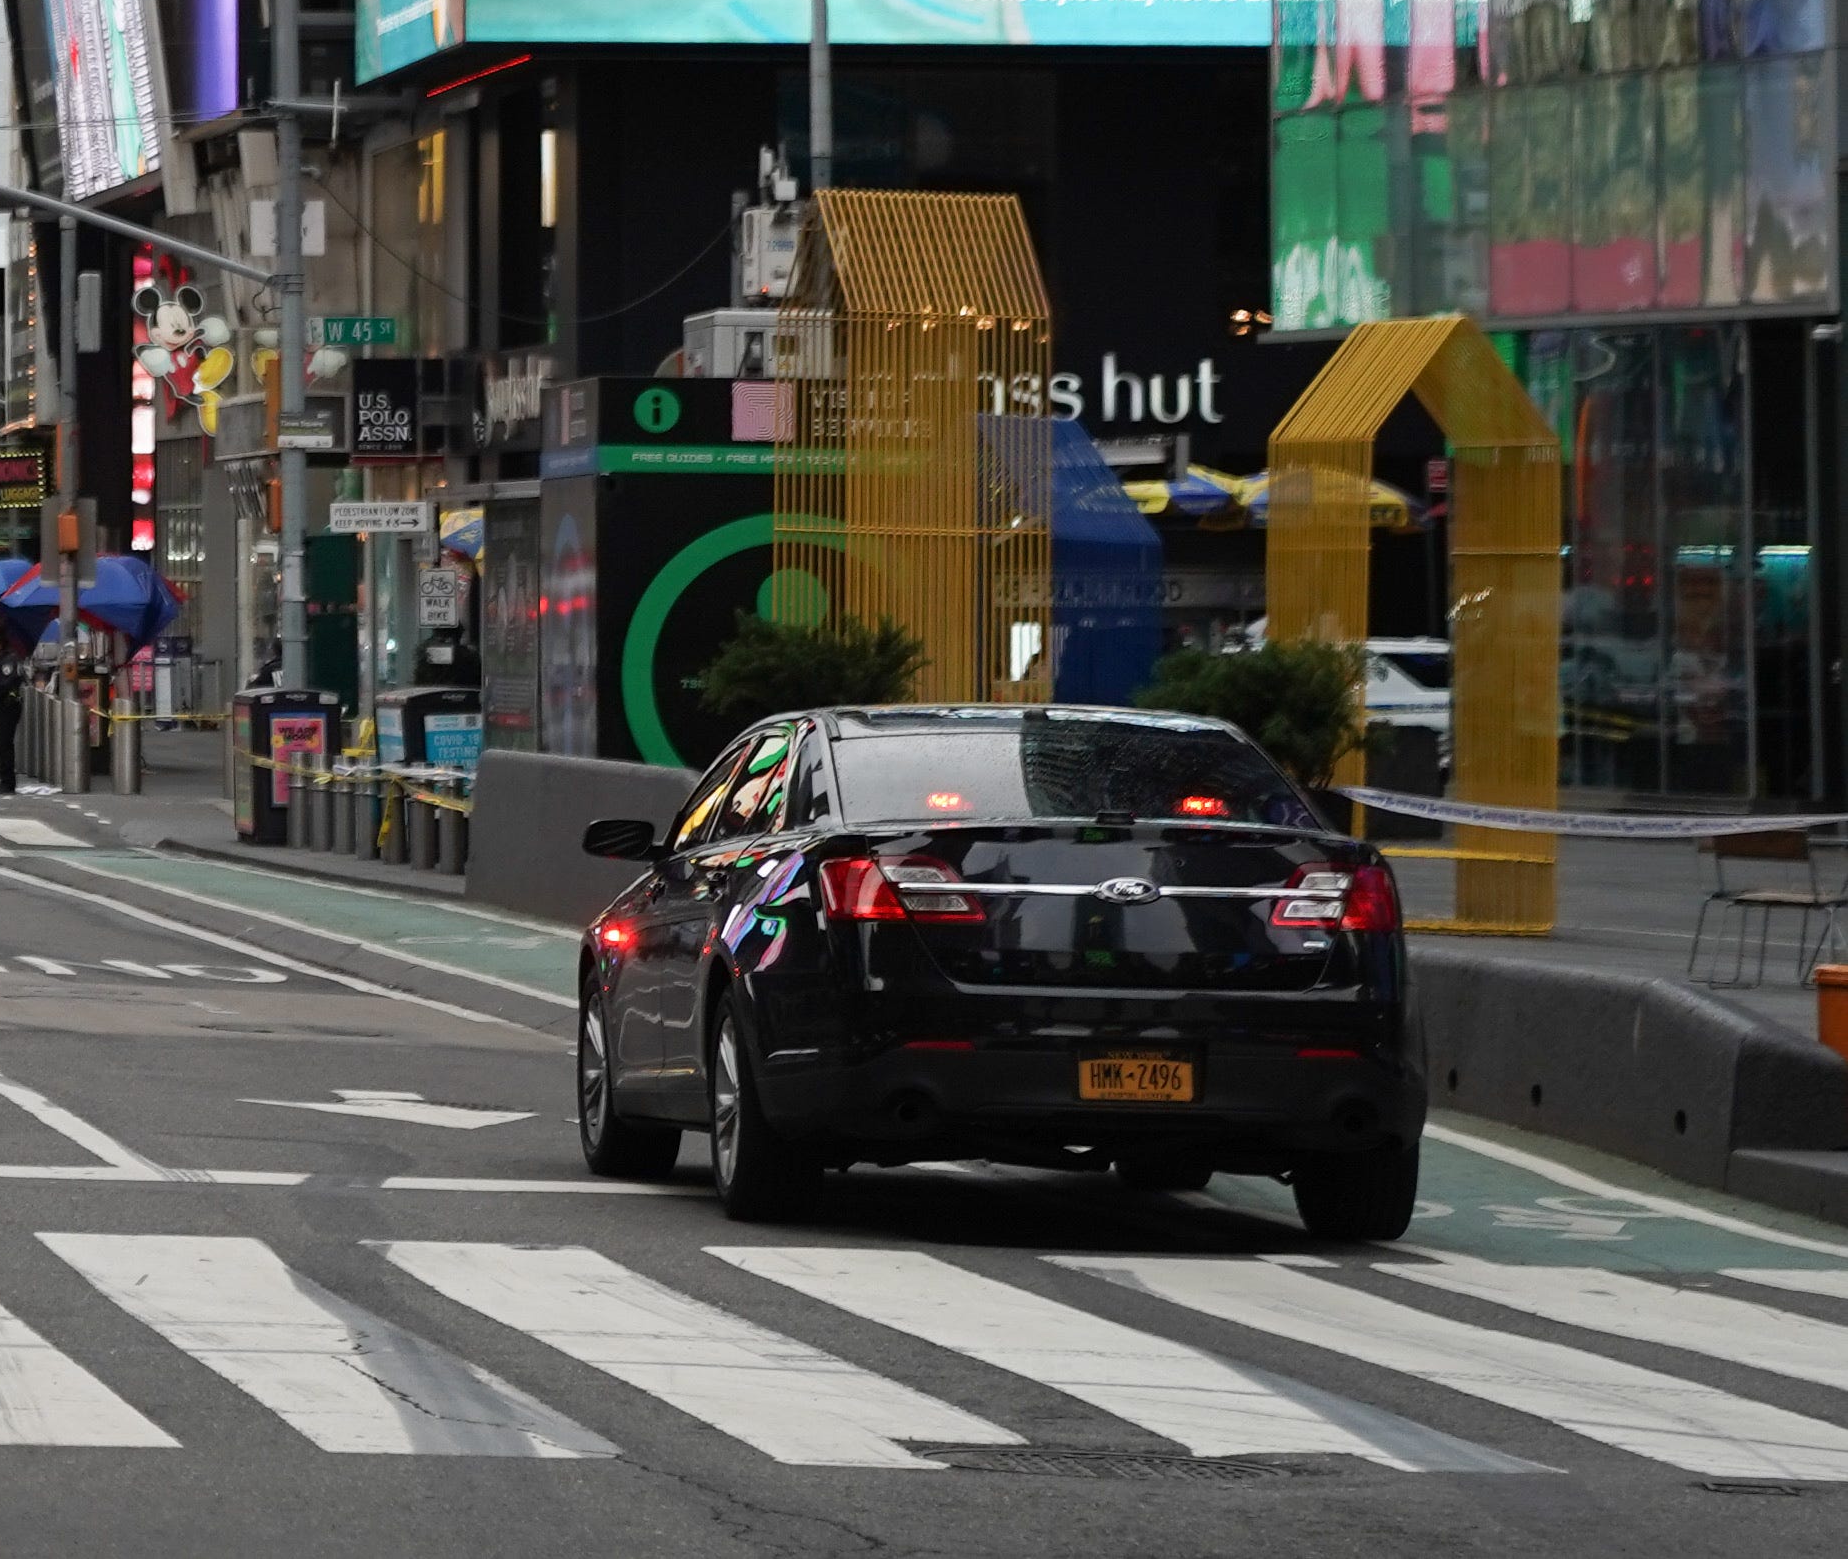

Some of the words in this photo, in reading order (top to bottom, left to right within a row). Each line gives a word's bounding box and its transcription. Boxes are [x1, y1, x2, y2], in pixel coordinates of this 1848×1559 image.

[327, 322, 343, 341] W
[351, 321, 373, 341] 45
[1101, 352, 1224, 424] hut
[358, 394, 392, 410] U.S.
[358, 410, 409, 426] POLO
[357, 426, 413, 442] ASSN.
[631, 453, 664, 465] FREE
[666, 453, 713, 465] GUIDES
[725, 453, 756, 465] FREE
[334, 506, 378, 517] PEDESTRIAN
[400, 506, 420, 516] ZONE
[335, 518, 353, 528] KEEP
[355, 517, 383, 528] MOVING
[425, 598, 451, 609] WALK
[426, 611, 449, 622] BIKE
